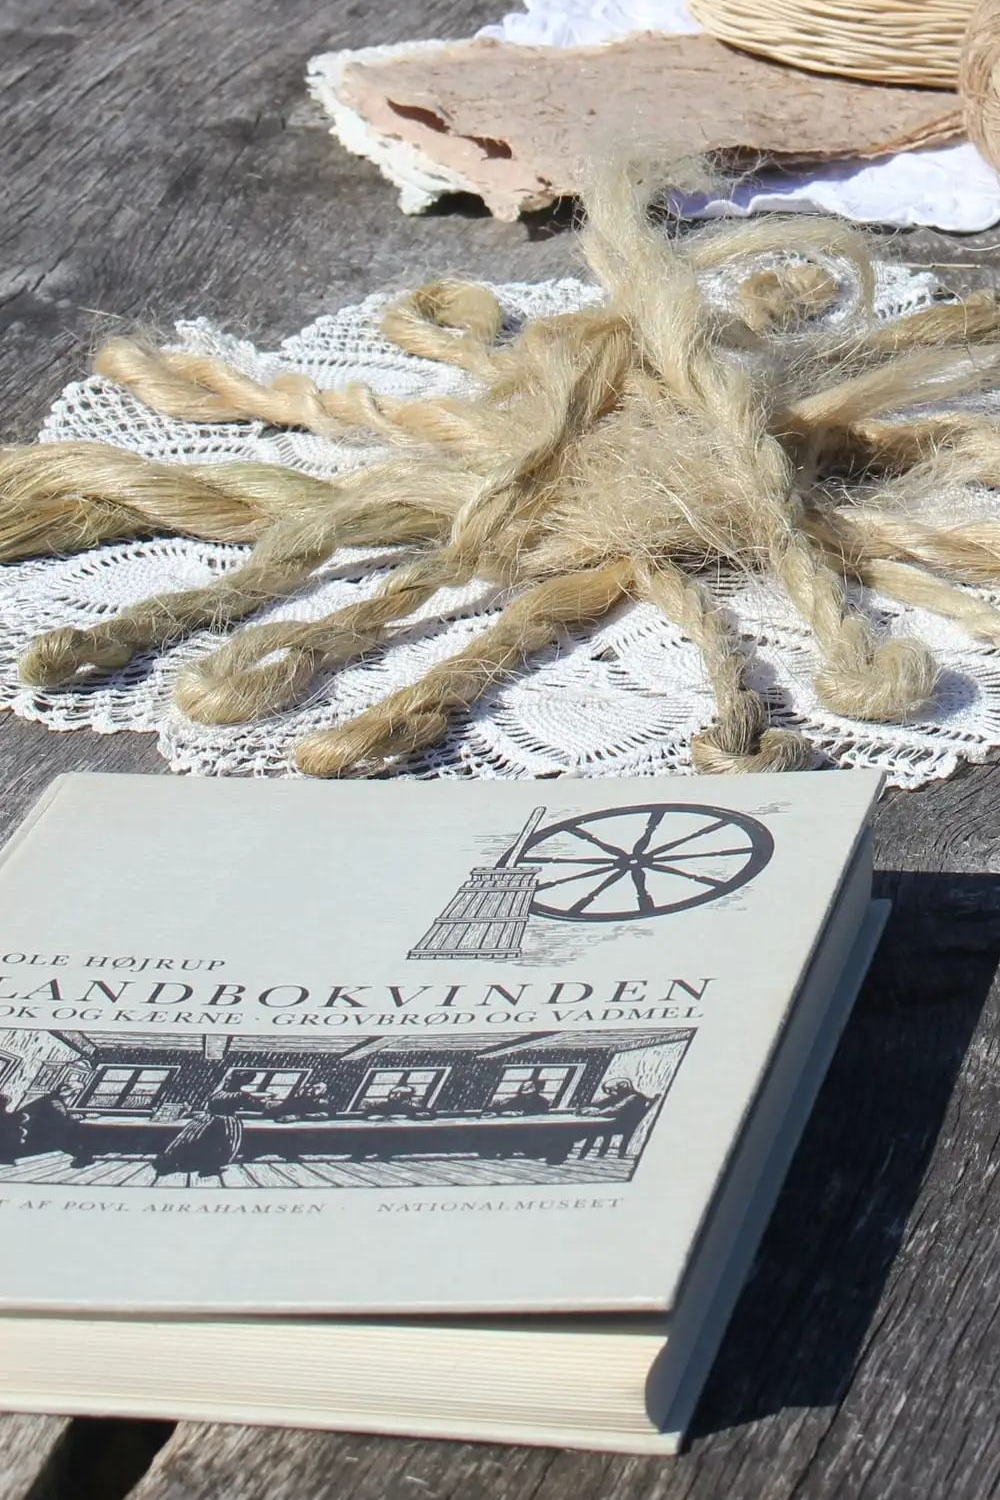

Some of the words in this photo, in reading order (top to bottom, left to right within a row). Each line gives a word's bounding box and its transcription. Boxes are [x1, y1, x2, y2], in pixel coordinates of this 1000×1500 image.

[2, 952, 70, 967] OLE
[83, 955, 226, 973] HØJRUP
[52, 1008, 103, 1020] OG
[112, 1009, 244, 1025] KÆRNE
[271, 1011, 476, 1028] GROVBRØD
[485, 1011, 538, 1024] OG
[551, 1006, 705, 1023] VADMEL
[18, 1200, 53, 1211] AF
[62, 1201, 131, 1213] POVL
[141, 1202, 328, 1215] ABRAHAMSEN
[377, 1198, 626, 1213] NATIONALMUSEET
